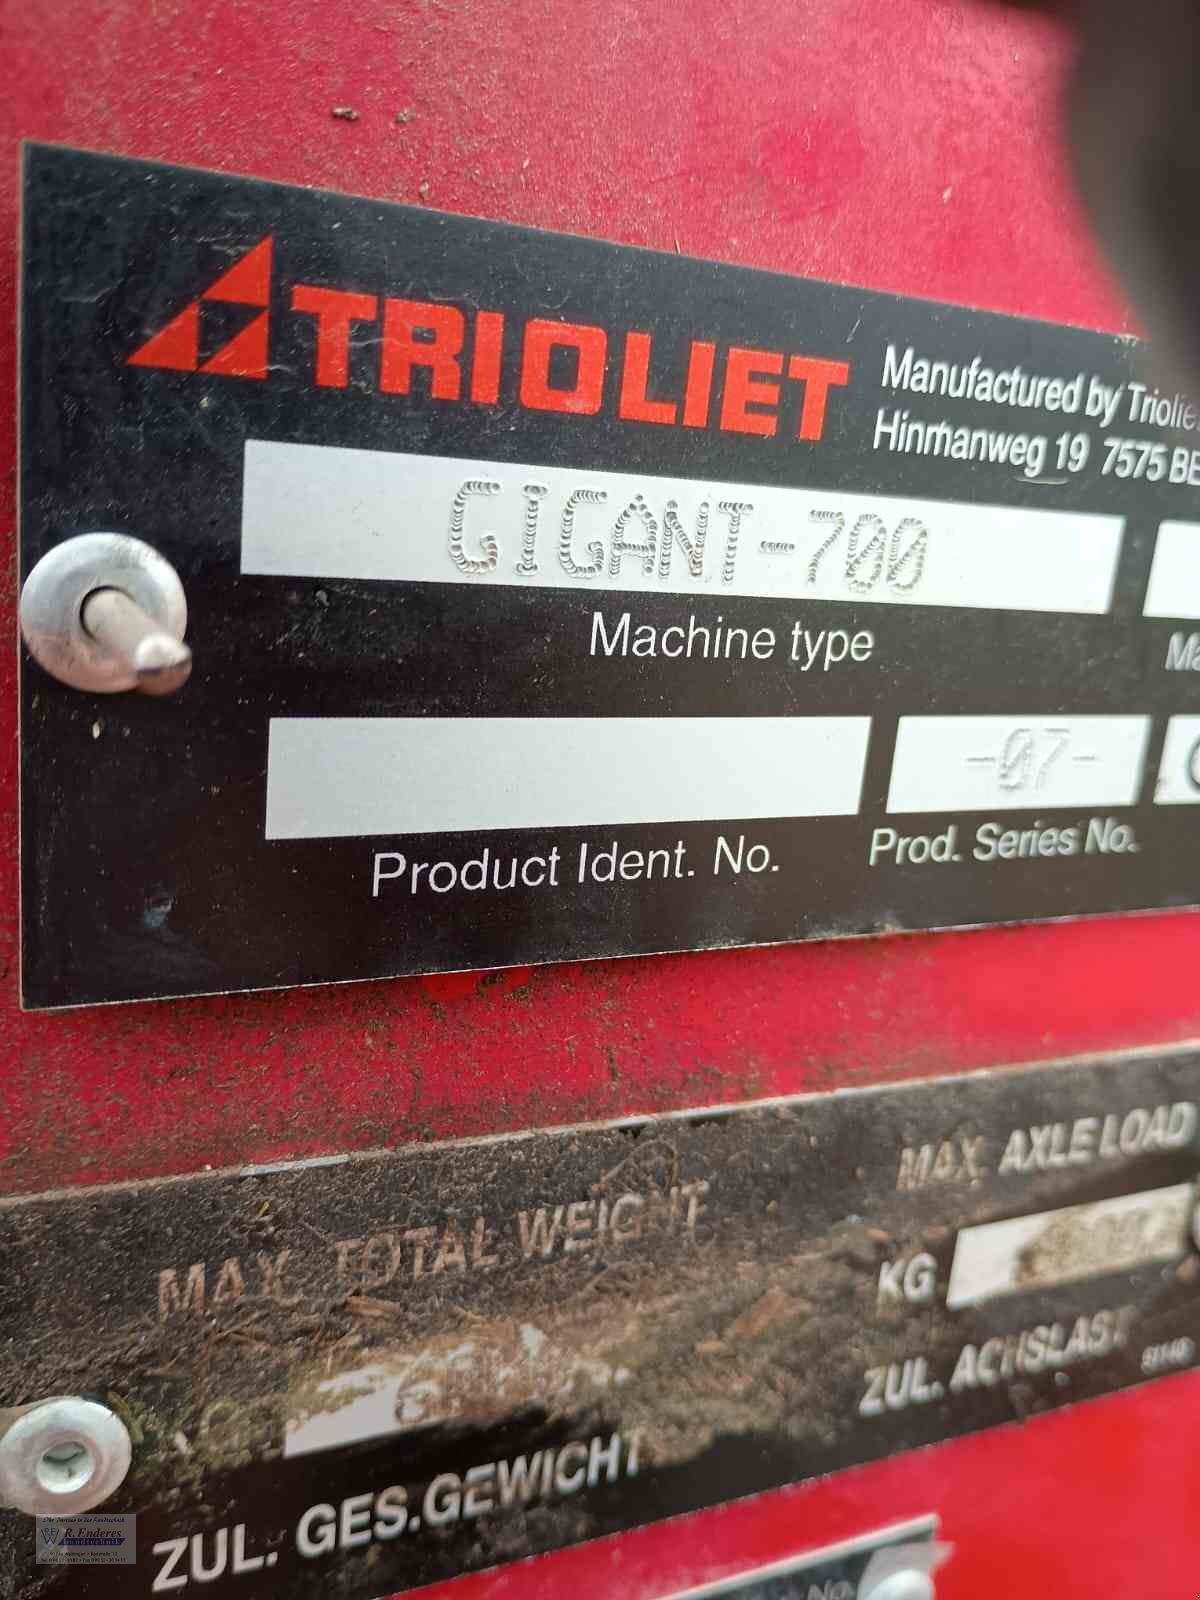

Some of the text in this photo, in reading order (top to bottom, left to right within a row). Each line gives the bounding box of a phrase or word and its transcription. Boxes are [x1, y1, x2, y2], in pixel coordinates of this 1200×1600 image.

[292, 284, 850, 442] TRIOLIET
[881, 344, 1200, 432] Manufactured by Triolie
[873, 408, 1047, 477] Hinmanweg
[1055, 431, 1091, 473] 19
[1101, 437, 1169, 482] 7575
[447, 479, 930, 596] GIGANT-700
[589, 611, 875, 672] Machine type
[372, 834, 781, 898] Product Ident. No.
[869, 815, 1142, 867] Prod. Series No.
[876, 1252, 939, 1309] KG
[858, 1356, 945, 1418] ZUL.
[151, 1523, 279, 1595] ZUL.
